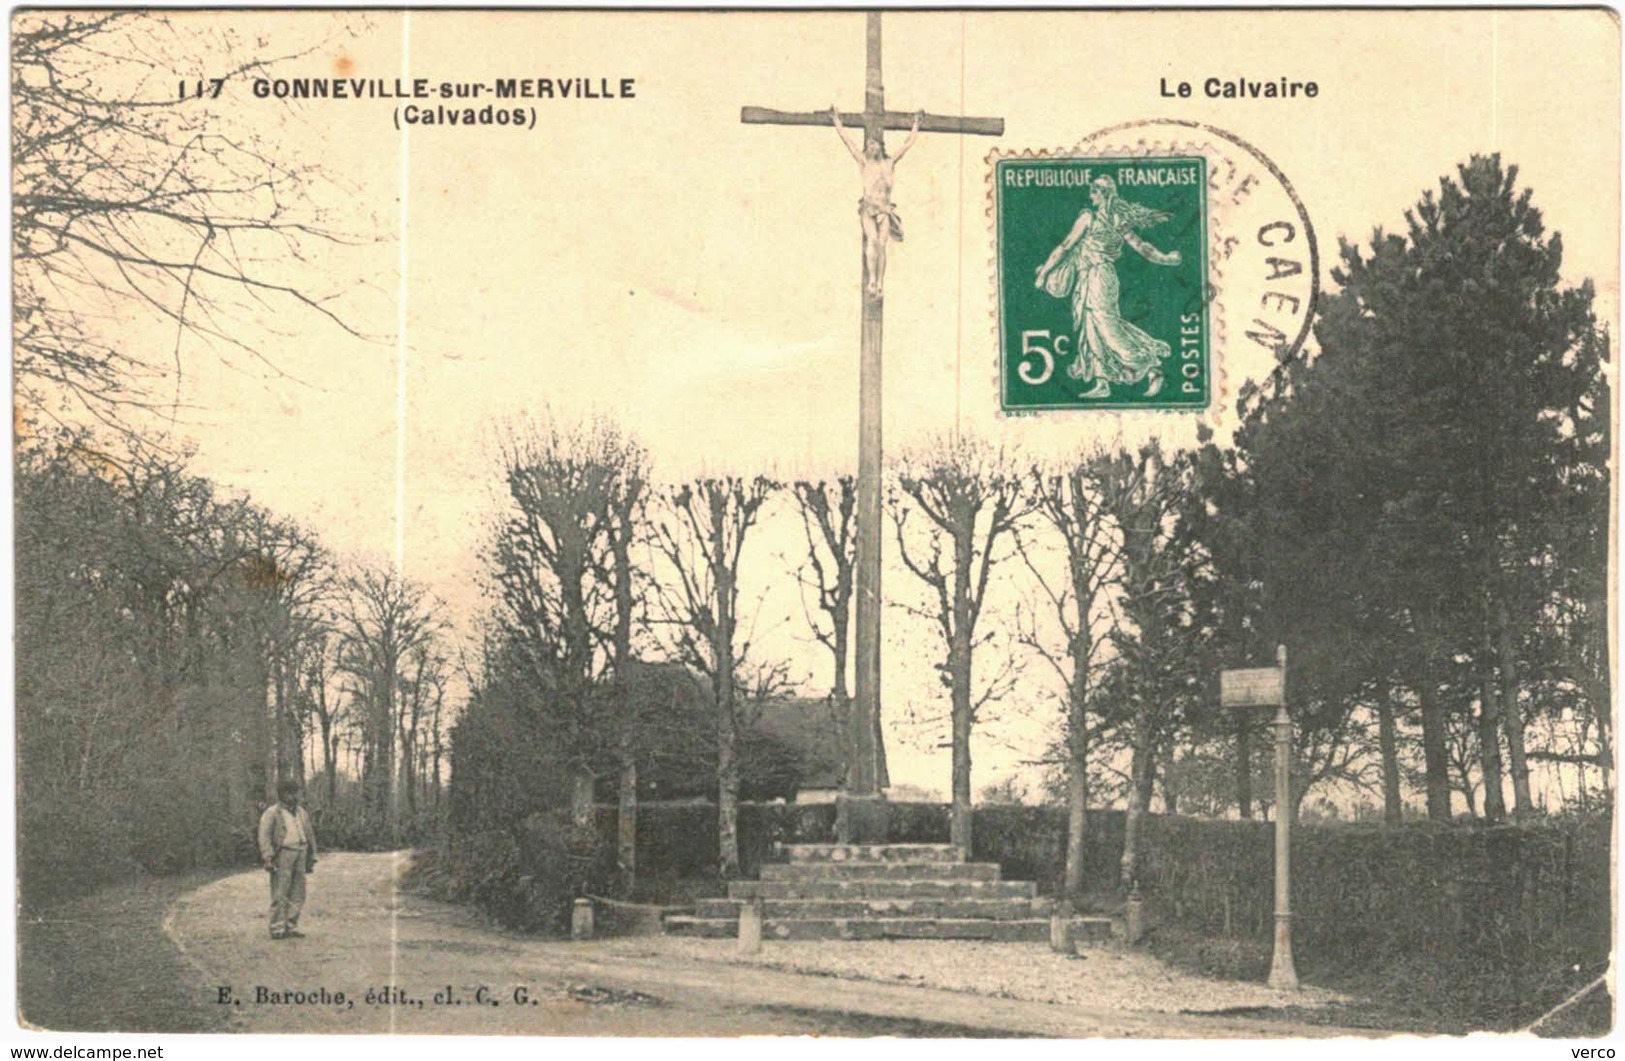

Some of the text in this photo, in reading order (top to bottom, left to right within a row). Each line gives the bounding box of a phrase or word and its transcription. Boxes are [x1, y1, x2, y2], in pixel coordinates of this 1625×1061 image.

[178, 78, 225, 99] 117
[1160, 76, 1319, 98] Le Calvaire
[393, 105, 537, 130] (Calvados)
[1118, 167, 1197, 188] FRANÇAISE
[1245, 220, 1303, 352] CAEN
[1181, 311, 1200, 393] POSTES
[217, 985, 540, 1009] E. Baroche, édit., cl. C. G.
